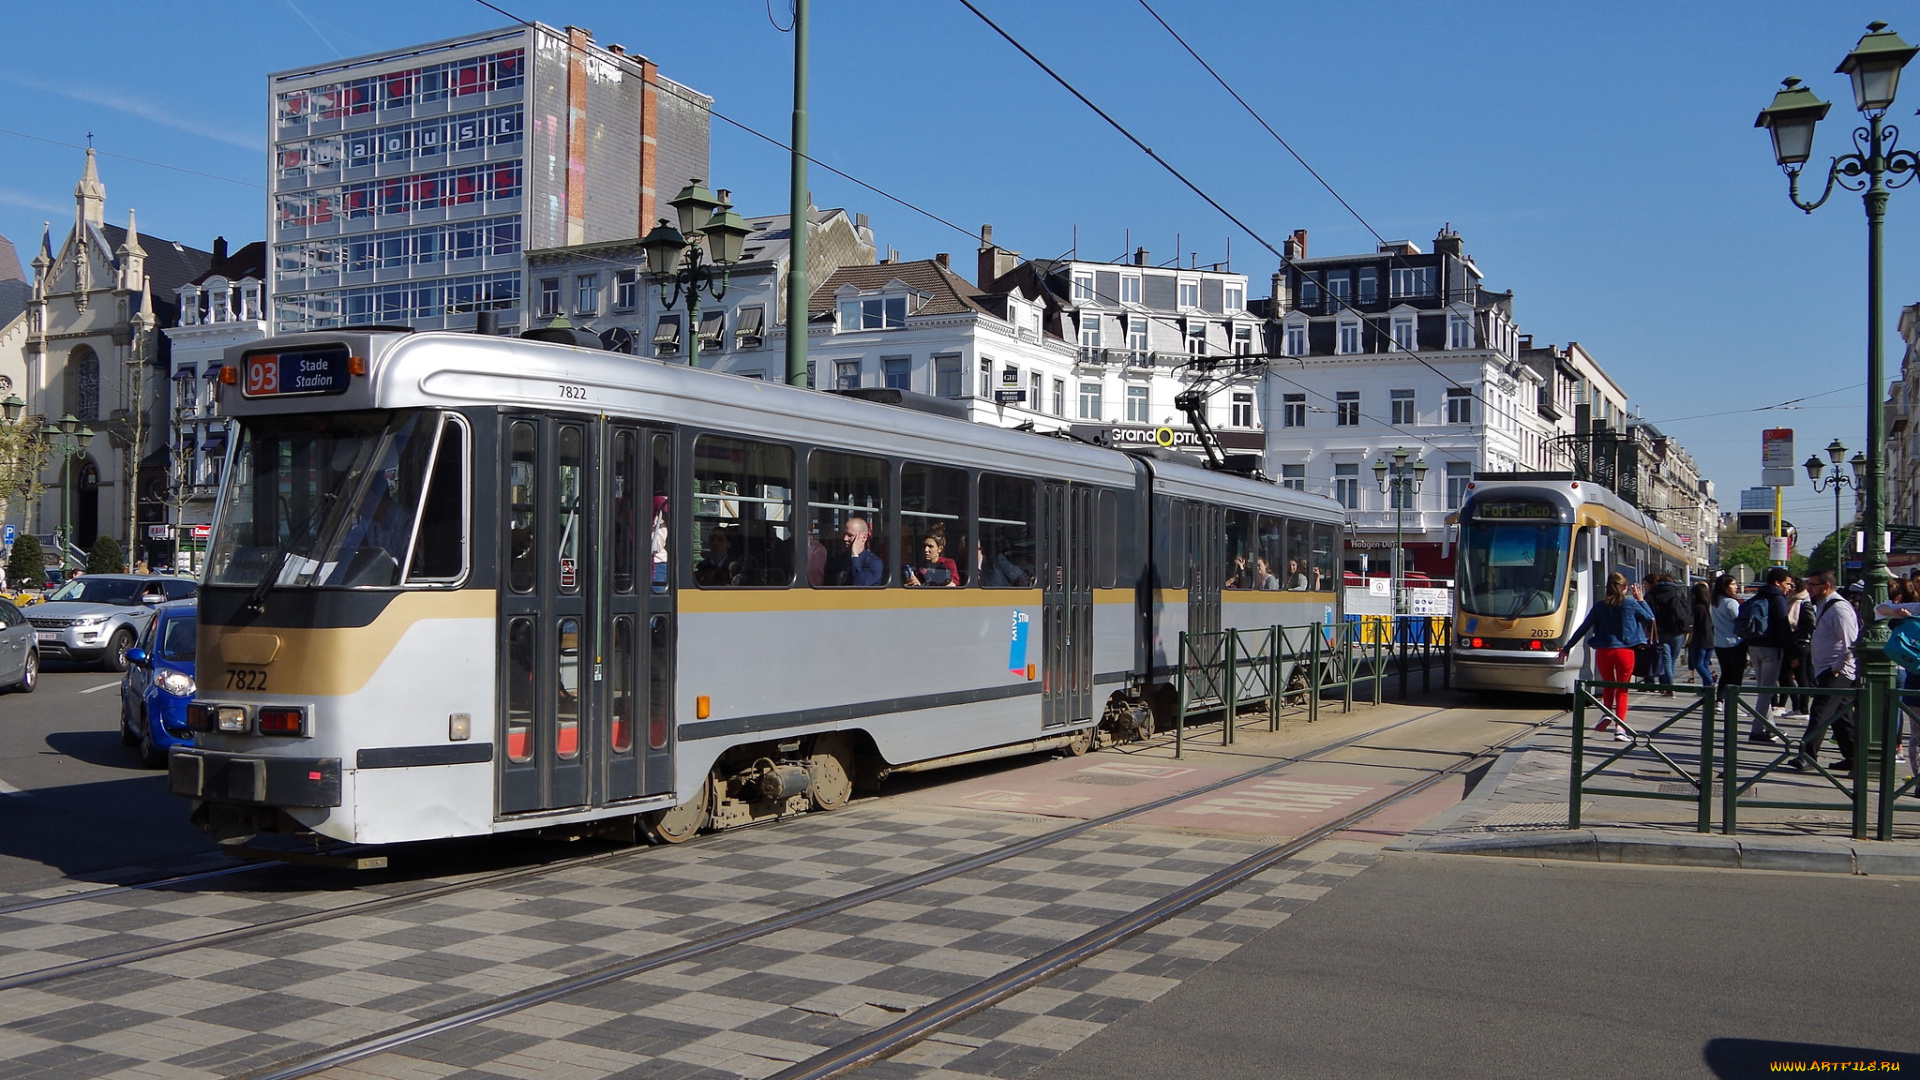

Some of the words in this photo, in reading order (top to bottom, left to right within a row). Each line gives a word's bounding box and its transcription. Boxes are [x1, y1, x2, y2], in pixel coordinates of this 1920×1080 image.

[300, 358, 328, 372] Stade
[250, 362, 277, 391] 93
[295, 373, 333, 388] Stadion
[559, 385, 587, 400] 7822
[1482, 503, 1550, 517] Fort-Jaco
[1531, 629, 1555, 638] 2037
[226, 669, 267, 691] 7822
